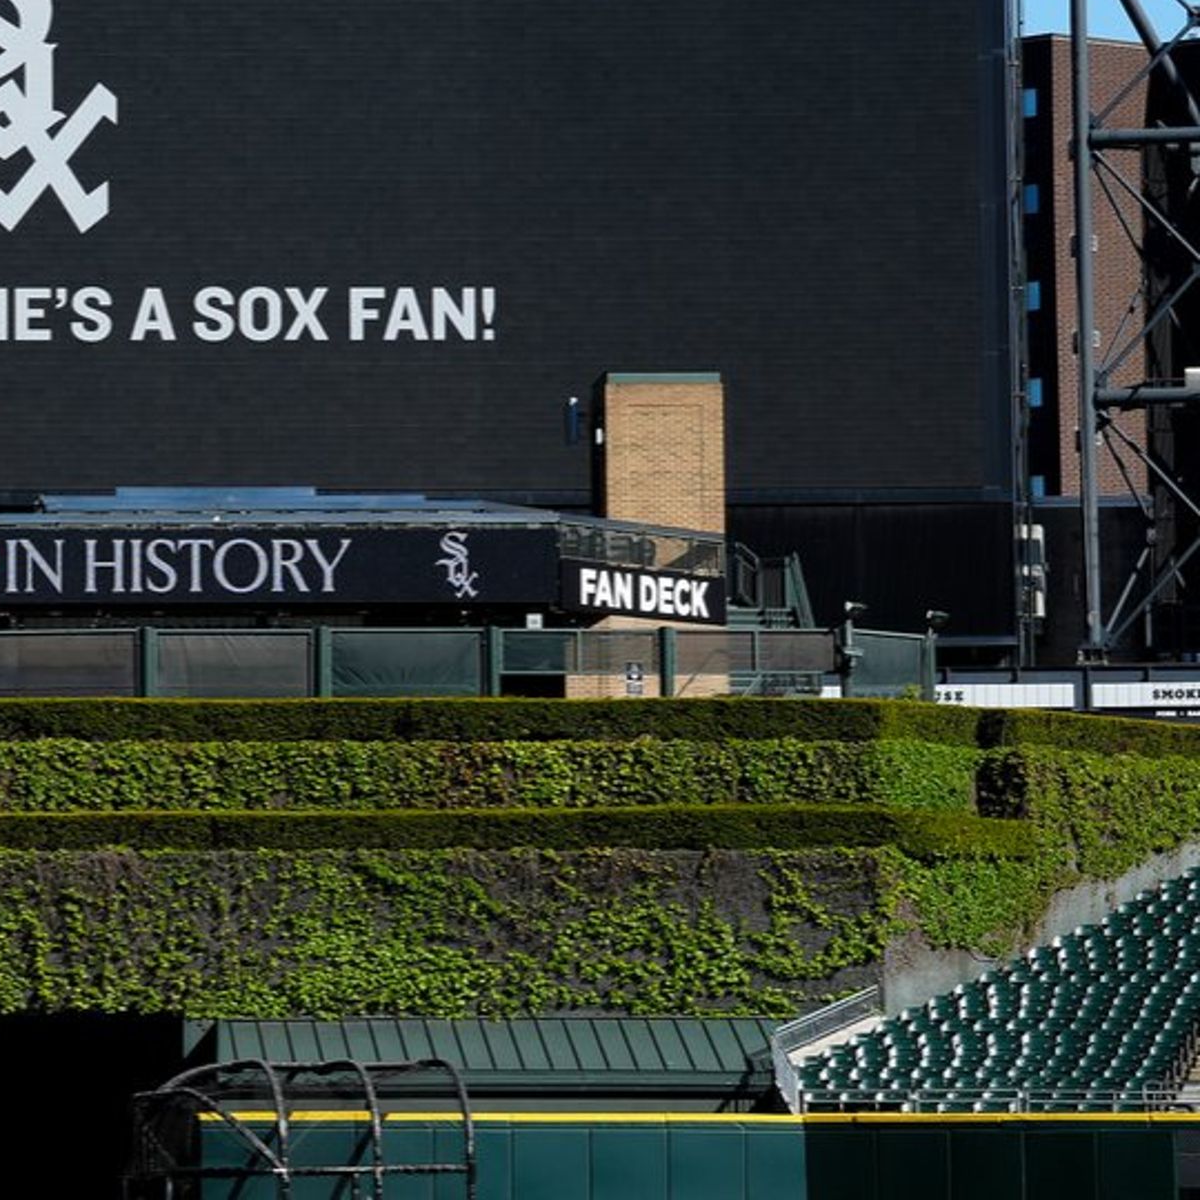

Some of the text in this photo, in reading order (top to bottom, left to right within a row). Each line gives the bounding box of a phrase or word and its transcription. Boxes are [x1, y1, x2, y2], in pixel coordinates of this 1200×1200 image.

[130, 288, 177, 341] A
[192, 287, 329, 342] SOX
[349, 287, 495, 341] FAN!
[5, 539, 65, 593] IN
[84, 539, 352, 593] HISTORY
[579, 568, 710, 618] FAN DECK
[1152, 689, 1200, 700] SMOK
